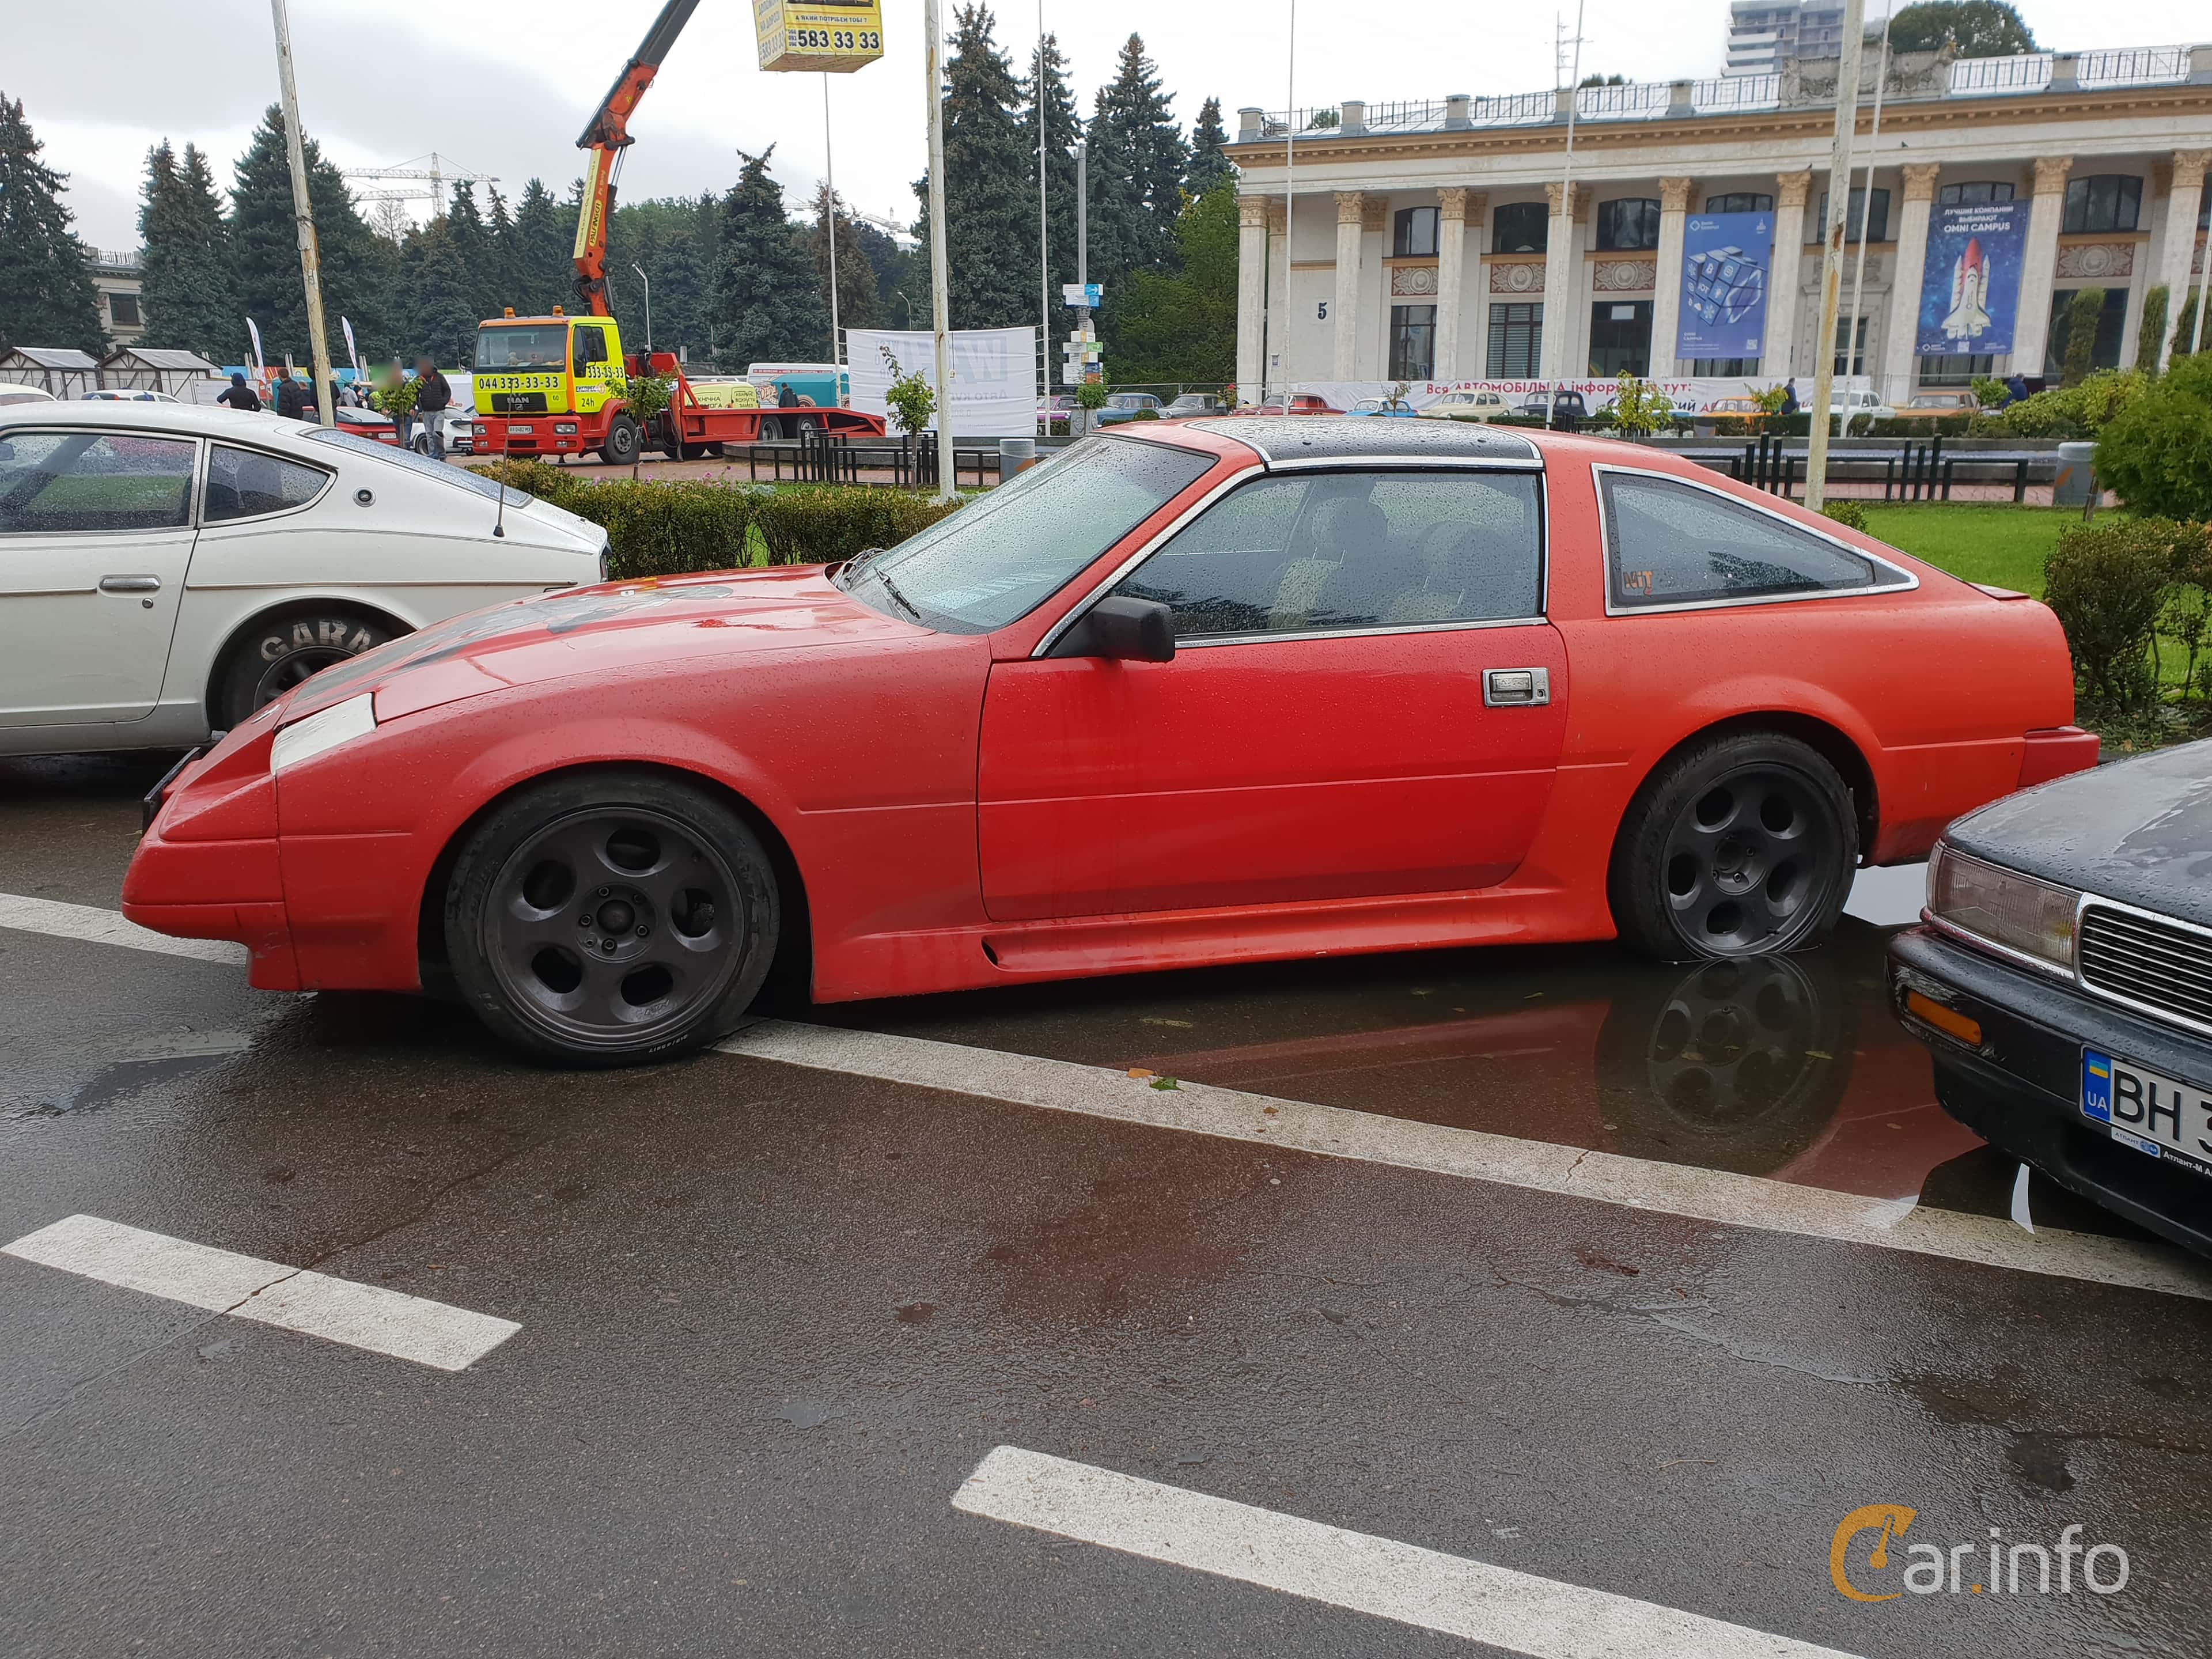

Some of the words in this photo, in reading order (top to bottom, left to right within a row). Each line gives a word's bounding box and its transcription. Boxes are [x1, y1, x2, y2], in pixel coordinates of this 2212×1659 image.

[798, 29, 830, 47] 583
[834, 31, 854, 48] 33
[859, 32, 879, 48] 33
[1944, 224, 1969, 233] OMNI
[1971, 222, 2010, 231] CAMPUS
[1317, 302, 1327, 320] 5
[479, 378, 497, 389] 044
[501, 376, 558, 389] 333-33-33
[1426, 384, 1449, 394] Вся
[1663, 384, 1692, 395] тут:
[581, 397, 594, 407] 24h
[2088, 1090, 2108, 1111] UA
[2113, 1069, 2182, 1142] BH
[2164, 1150, 2203, 1173] Атлант-М
